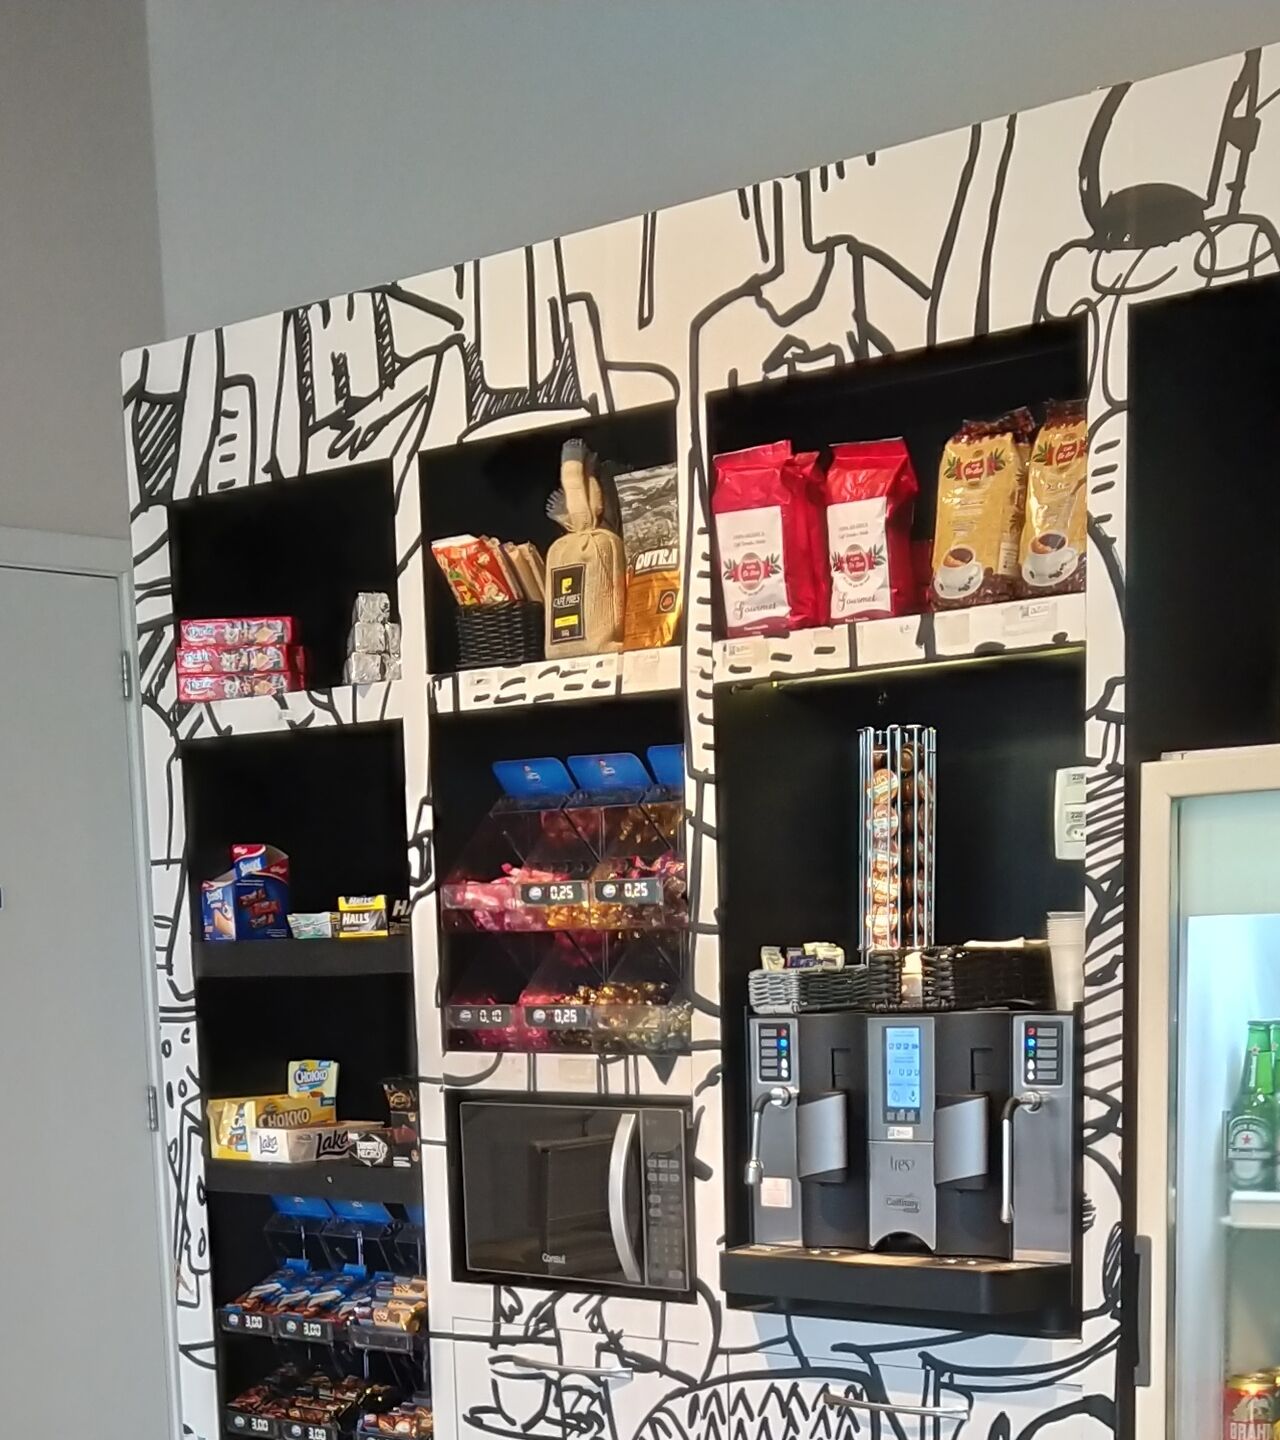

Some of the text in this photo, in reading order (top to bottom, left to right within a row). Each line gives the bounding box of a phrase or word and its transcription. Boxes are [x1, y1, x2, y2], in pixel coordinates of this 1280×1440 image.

[635, 548, 677, 568] DUTRA
[550, 885, 574, 900] 0,25
[624, 882, 648, 898] 0,25
[342, 912, 370, 924] HALLS
[258, 1109, 310, 1128] CHOKKO
[316, 1130, 349, 1157] Laka
[542, 1253, 566, 1264] Consul
[1230, 1422, 1271, 1440] BRAH
